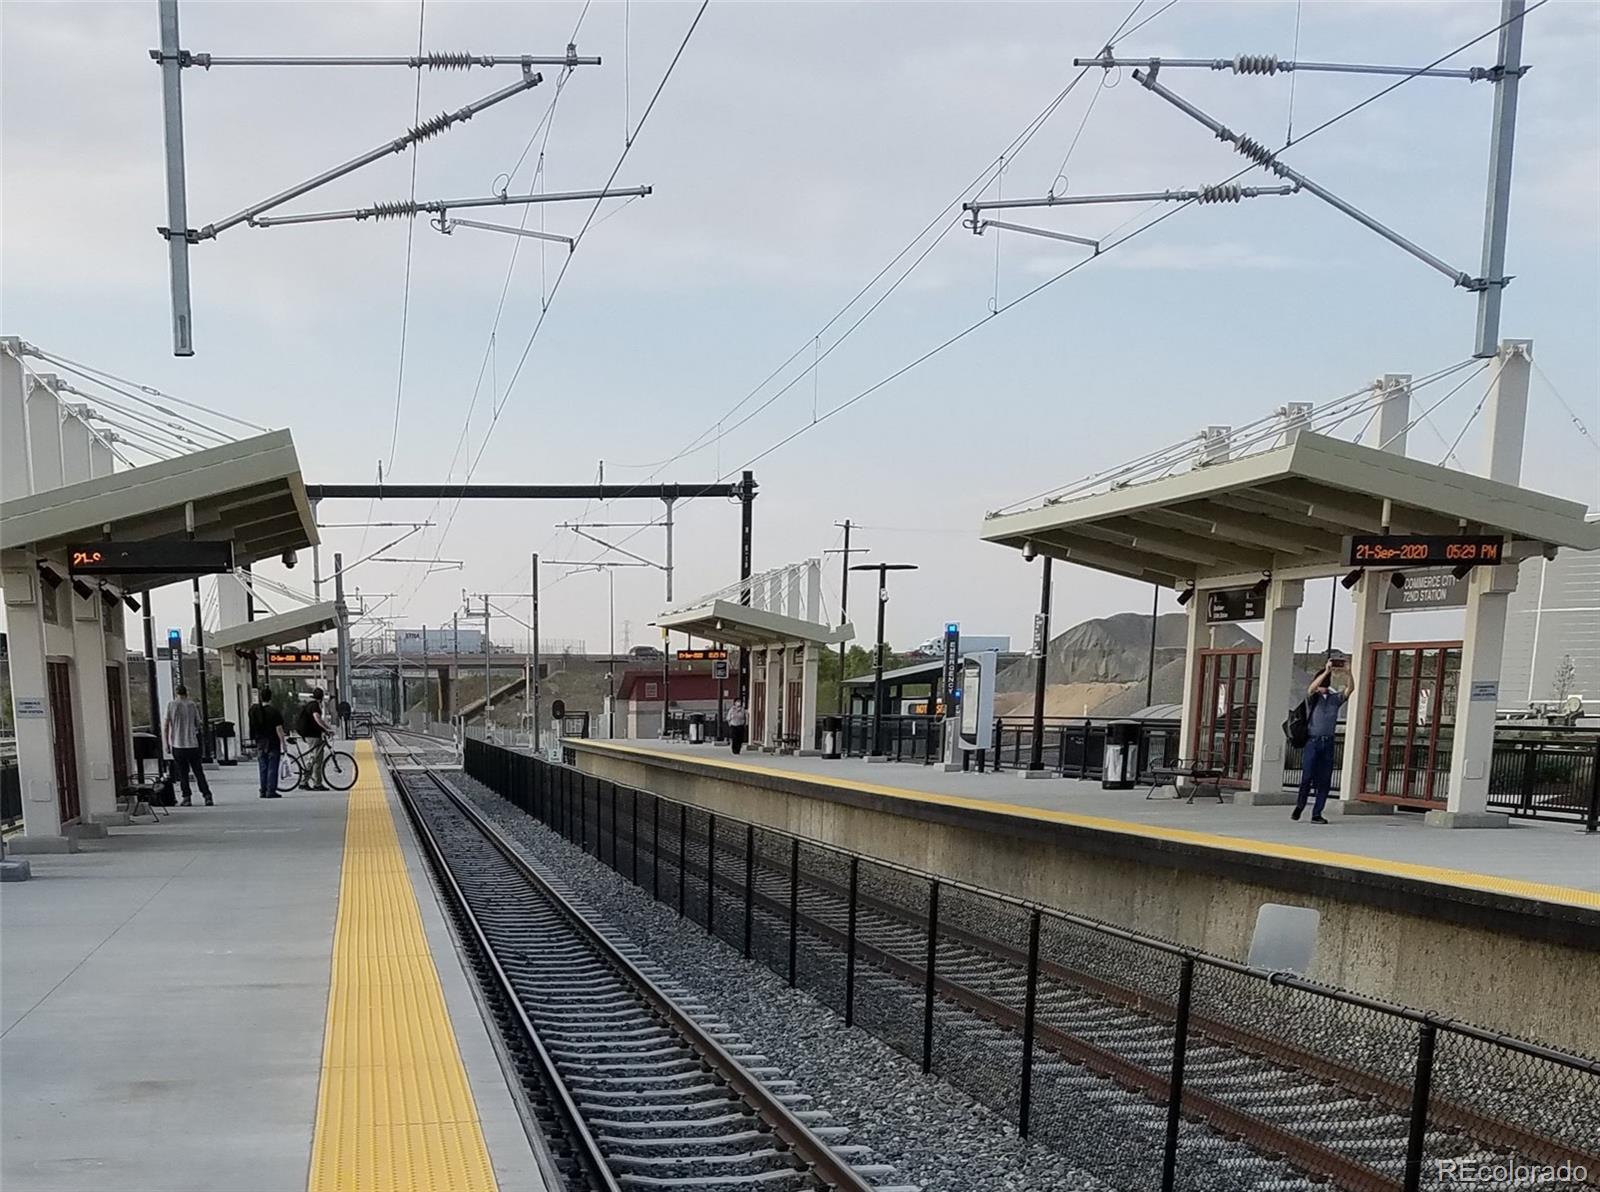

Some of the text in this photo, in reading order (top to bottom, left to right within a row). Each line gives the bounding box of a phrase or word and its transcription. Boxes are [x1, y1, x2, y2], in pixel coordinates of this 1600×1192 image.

[1356, 544, 1497, 559] 21-Sep-2020 05:29 PM
[1403, 575, 1441, 590] COMMERCE
[1402, 588, 1447, 602] 72ND STATION
